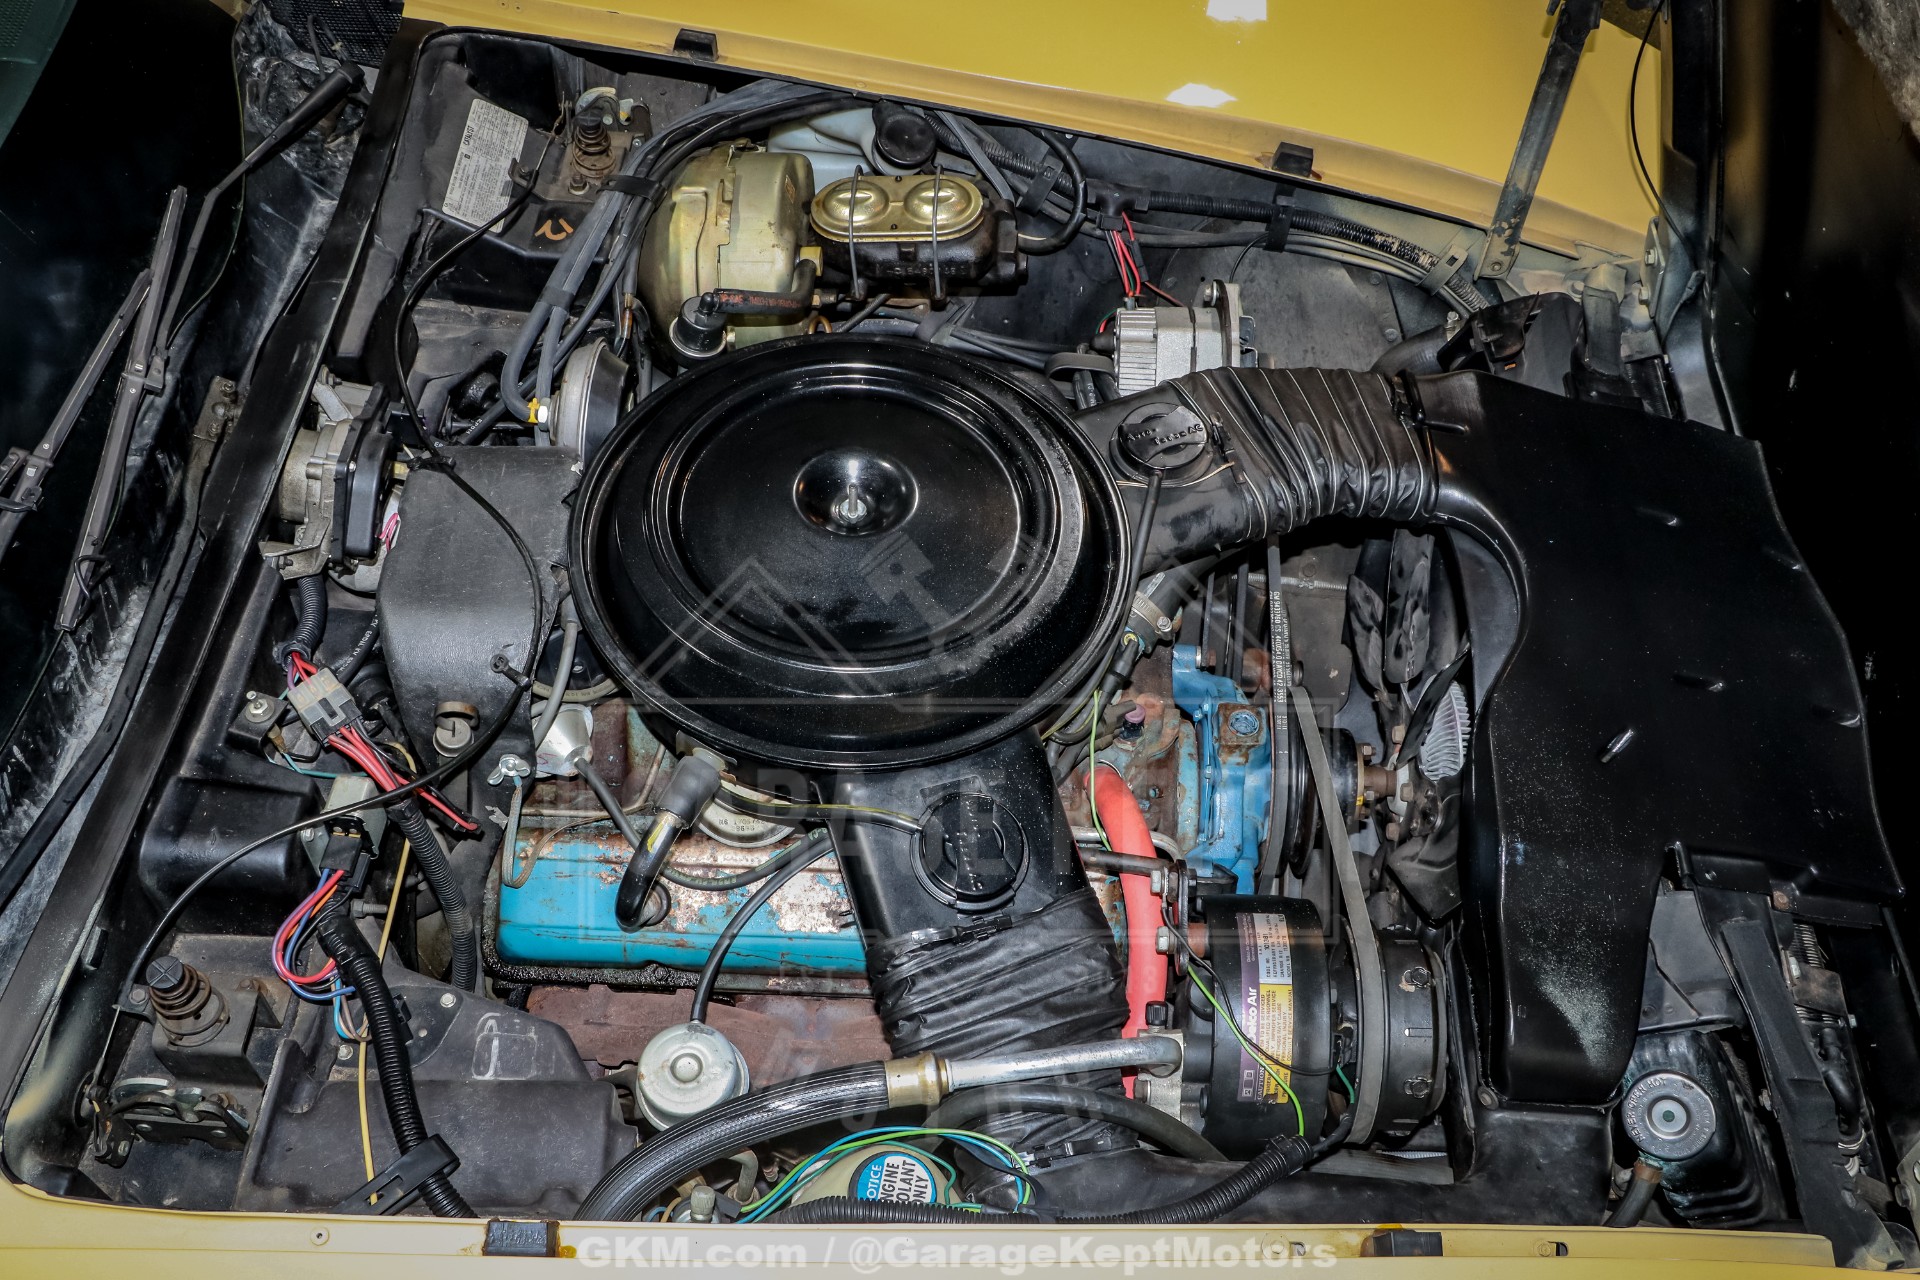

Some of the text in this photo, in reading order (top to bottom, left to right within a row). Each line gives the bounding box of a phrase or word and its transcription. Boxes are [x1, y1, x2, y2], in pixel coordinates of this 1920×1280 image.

[866, 1164, 882, 1200] OTICE
[879, 1162, 900, 1202] NGINE
[896, 1160, 916, 1202] OLANT
